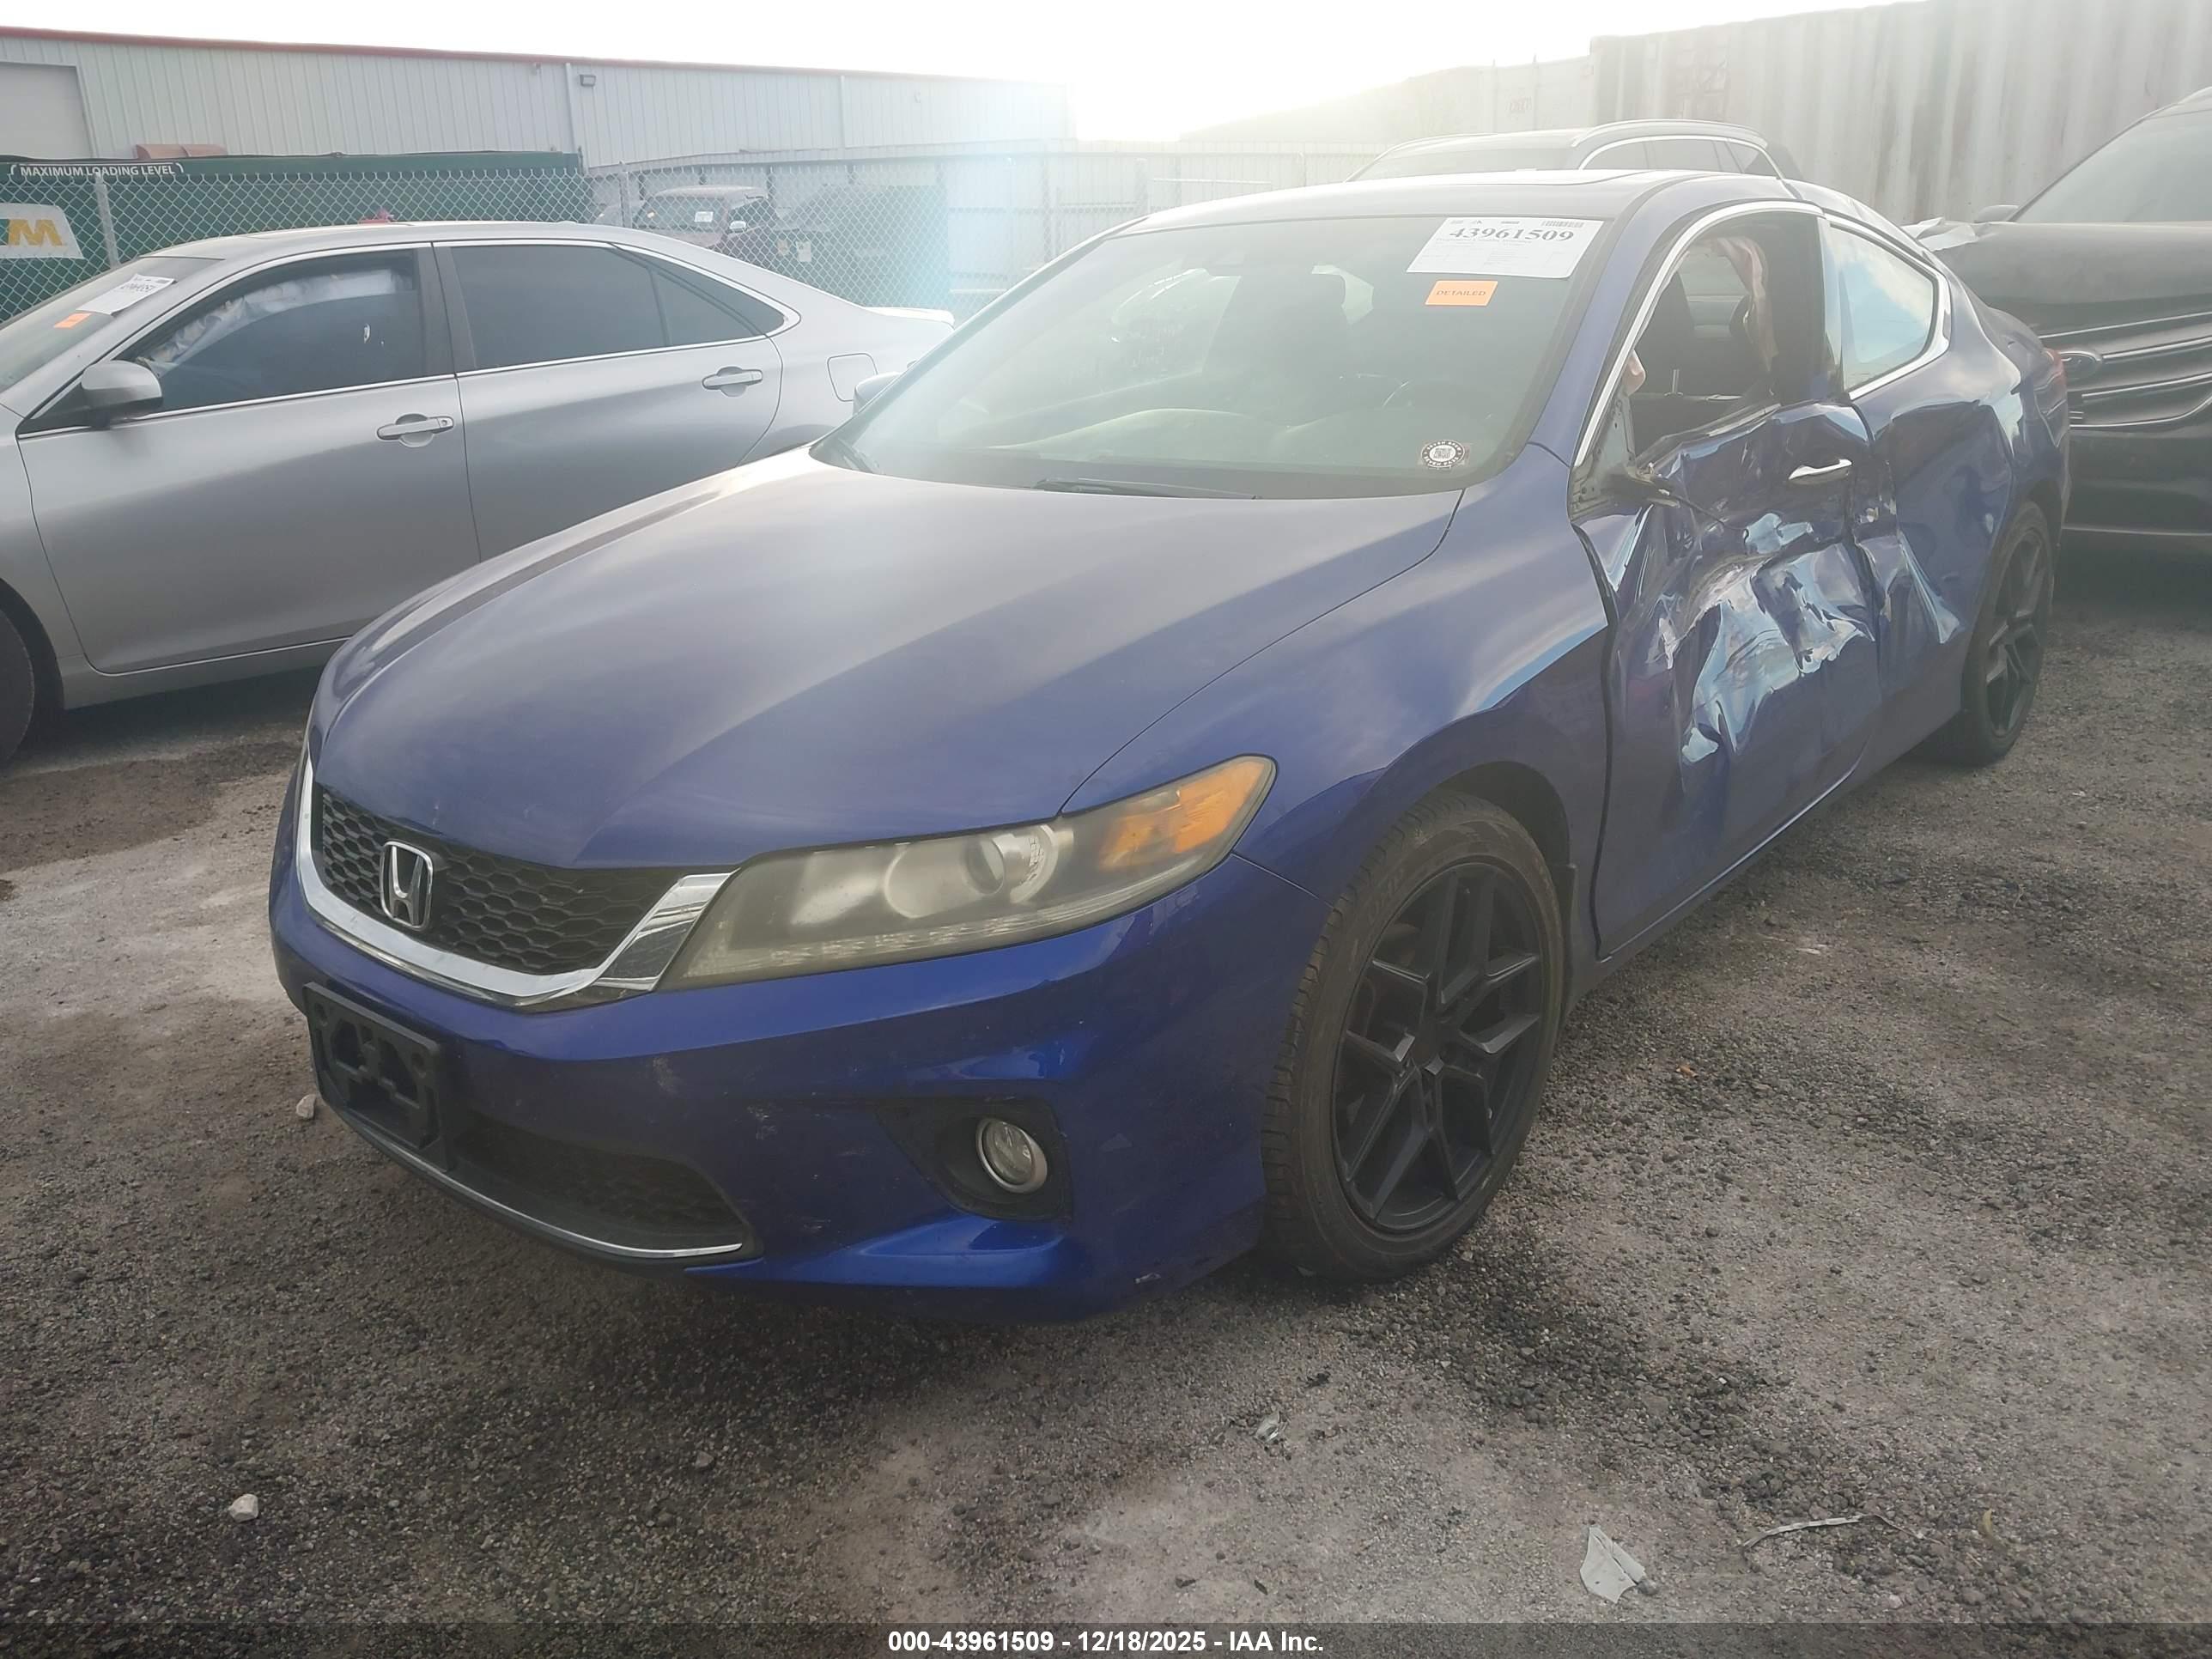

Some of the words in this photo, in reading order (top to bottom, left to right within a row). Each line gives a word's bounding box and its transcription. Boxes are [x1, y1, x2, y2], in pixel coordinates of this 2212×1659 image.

[21, 166, 84, 176] MAXIMUM
[86, 166, 139, 176] LOADING
[143, 166, 175, 175] LEVEL
[0, 218, 63, 246] M
[1449, 228, 1574, 241] 43961509
